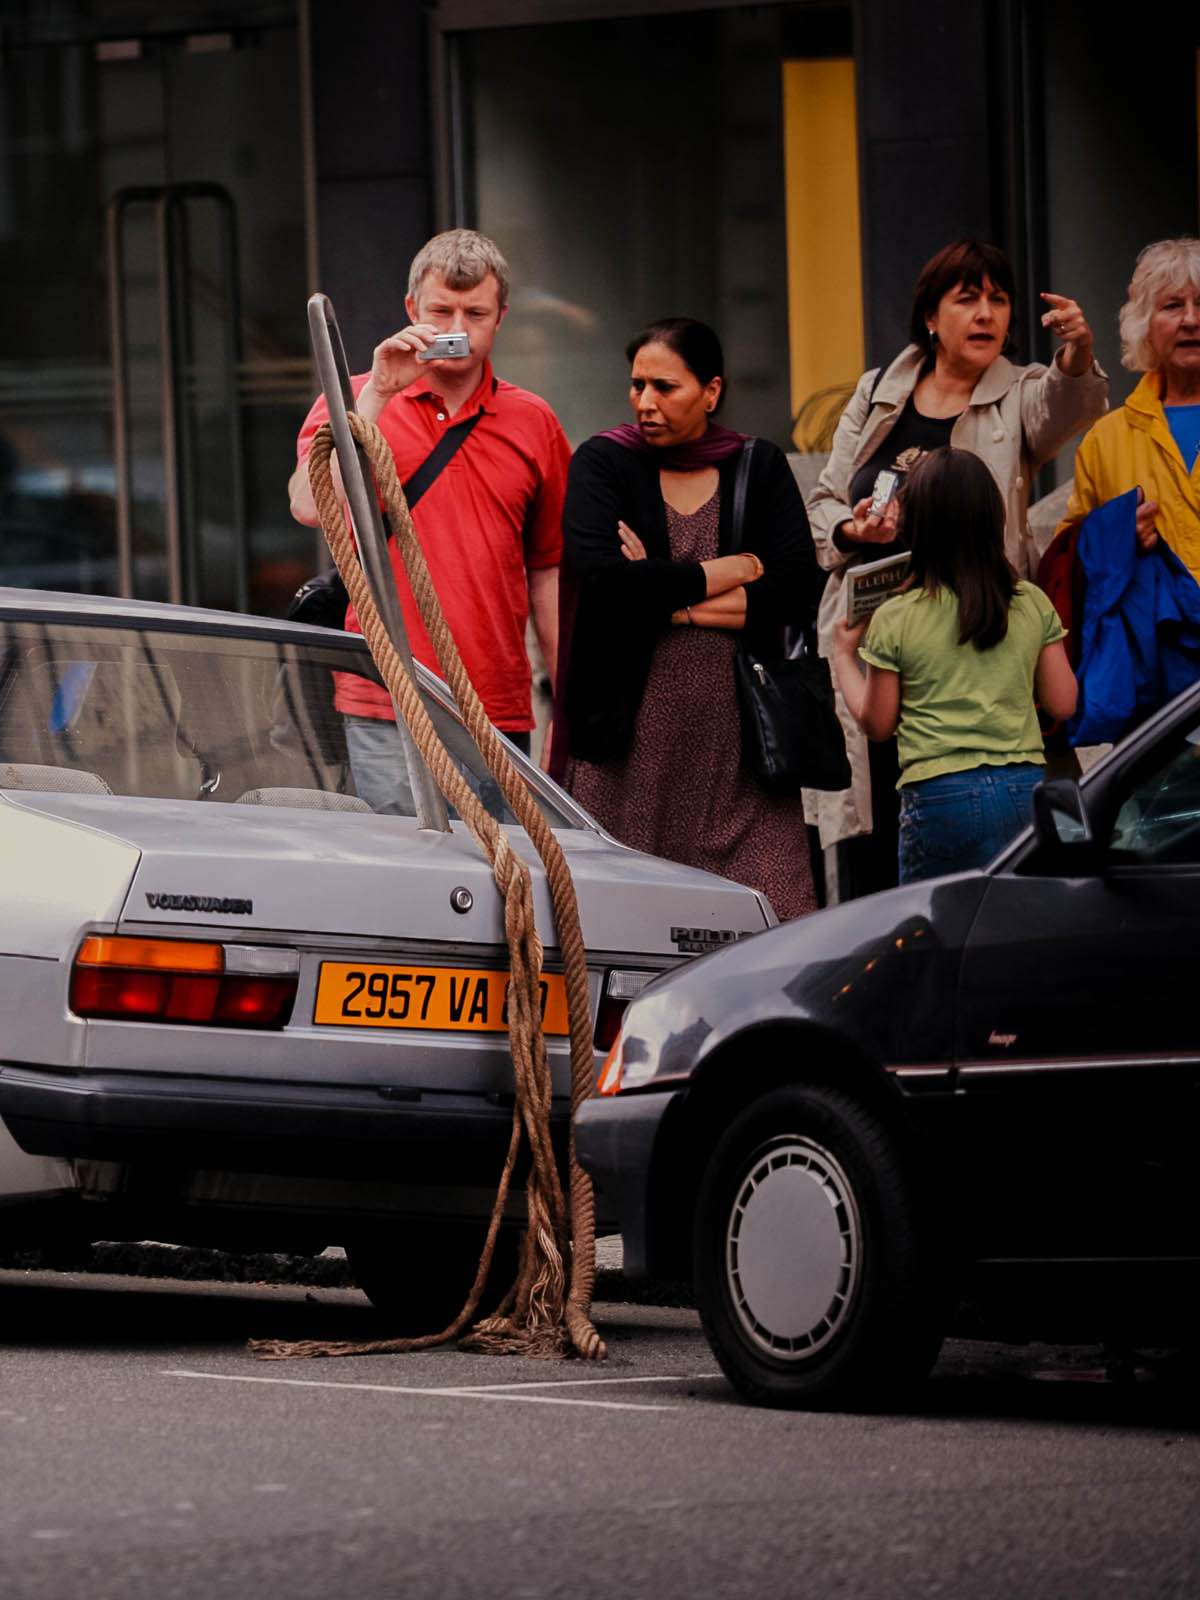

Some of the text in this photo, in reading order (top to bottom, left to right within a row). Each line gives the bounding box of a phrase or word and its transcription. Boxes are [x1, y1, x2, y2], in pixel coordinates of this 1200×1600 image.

[145, 892, 253, 915] VOLKSWAGEN
[670, 926, 737, 944] POLO
[341, 972, 436, 1021] 2957
[450, 976, 489, 1024] VA
